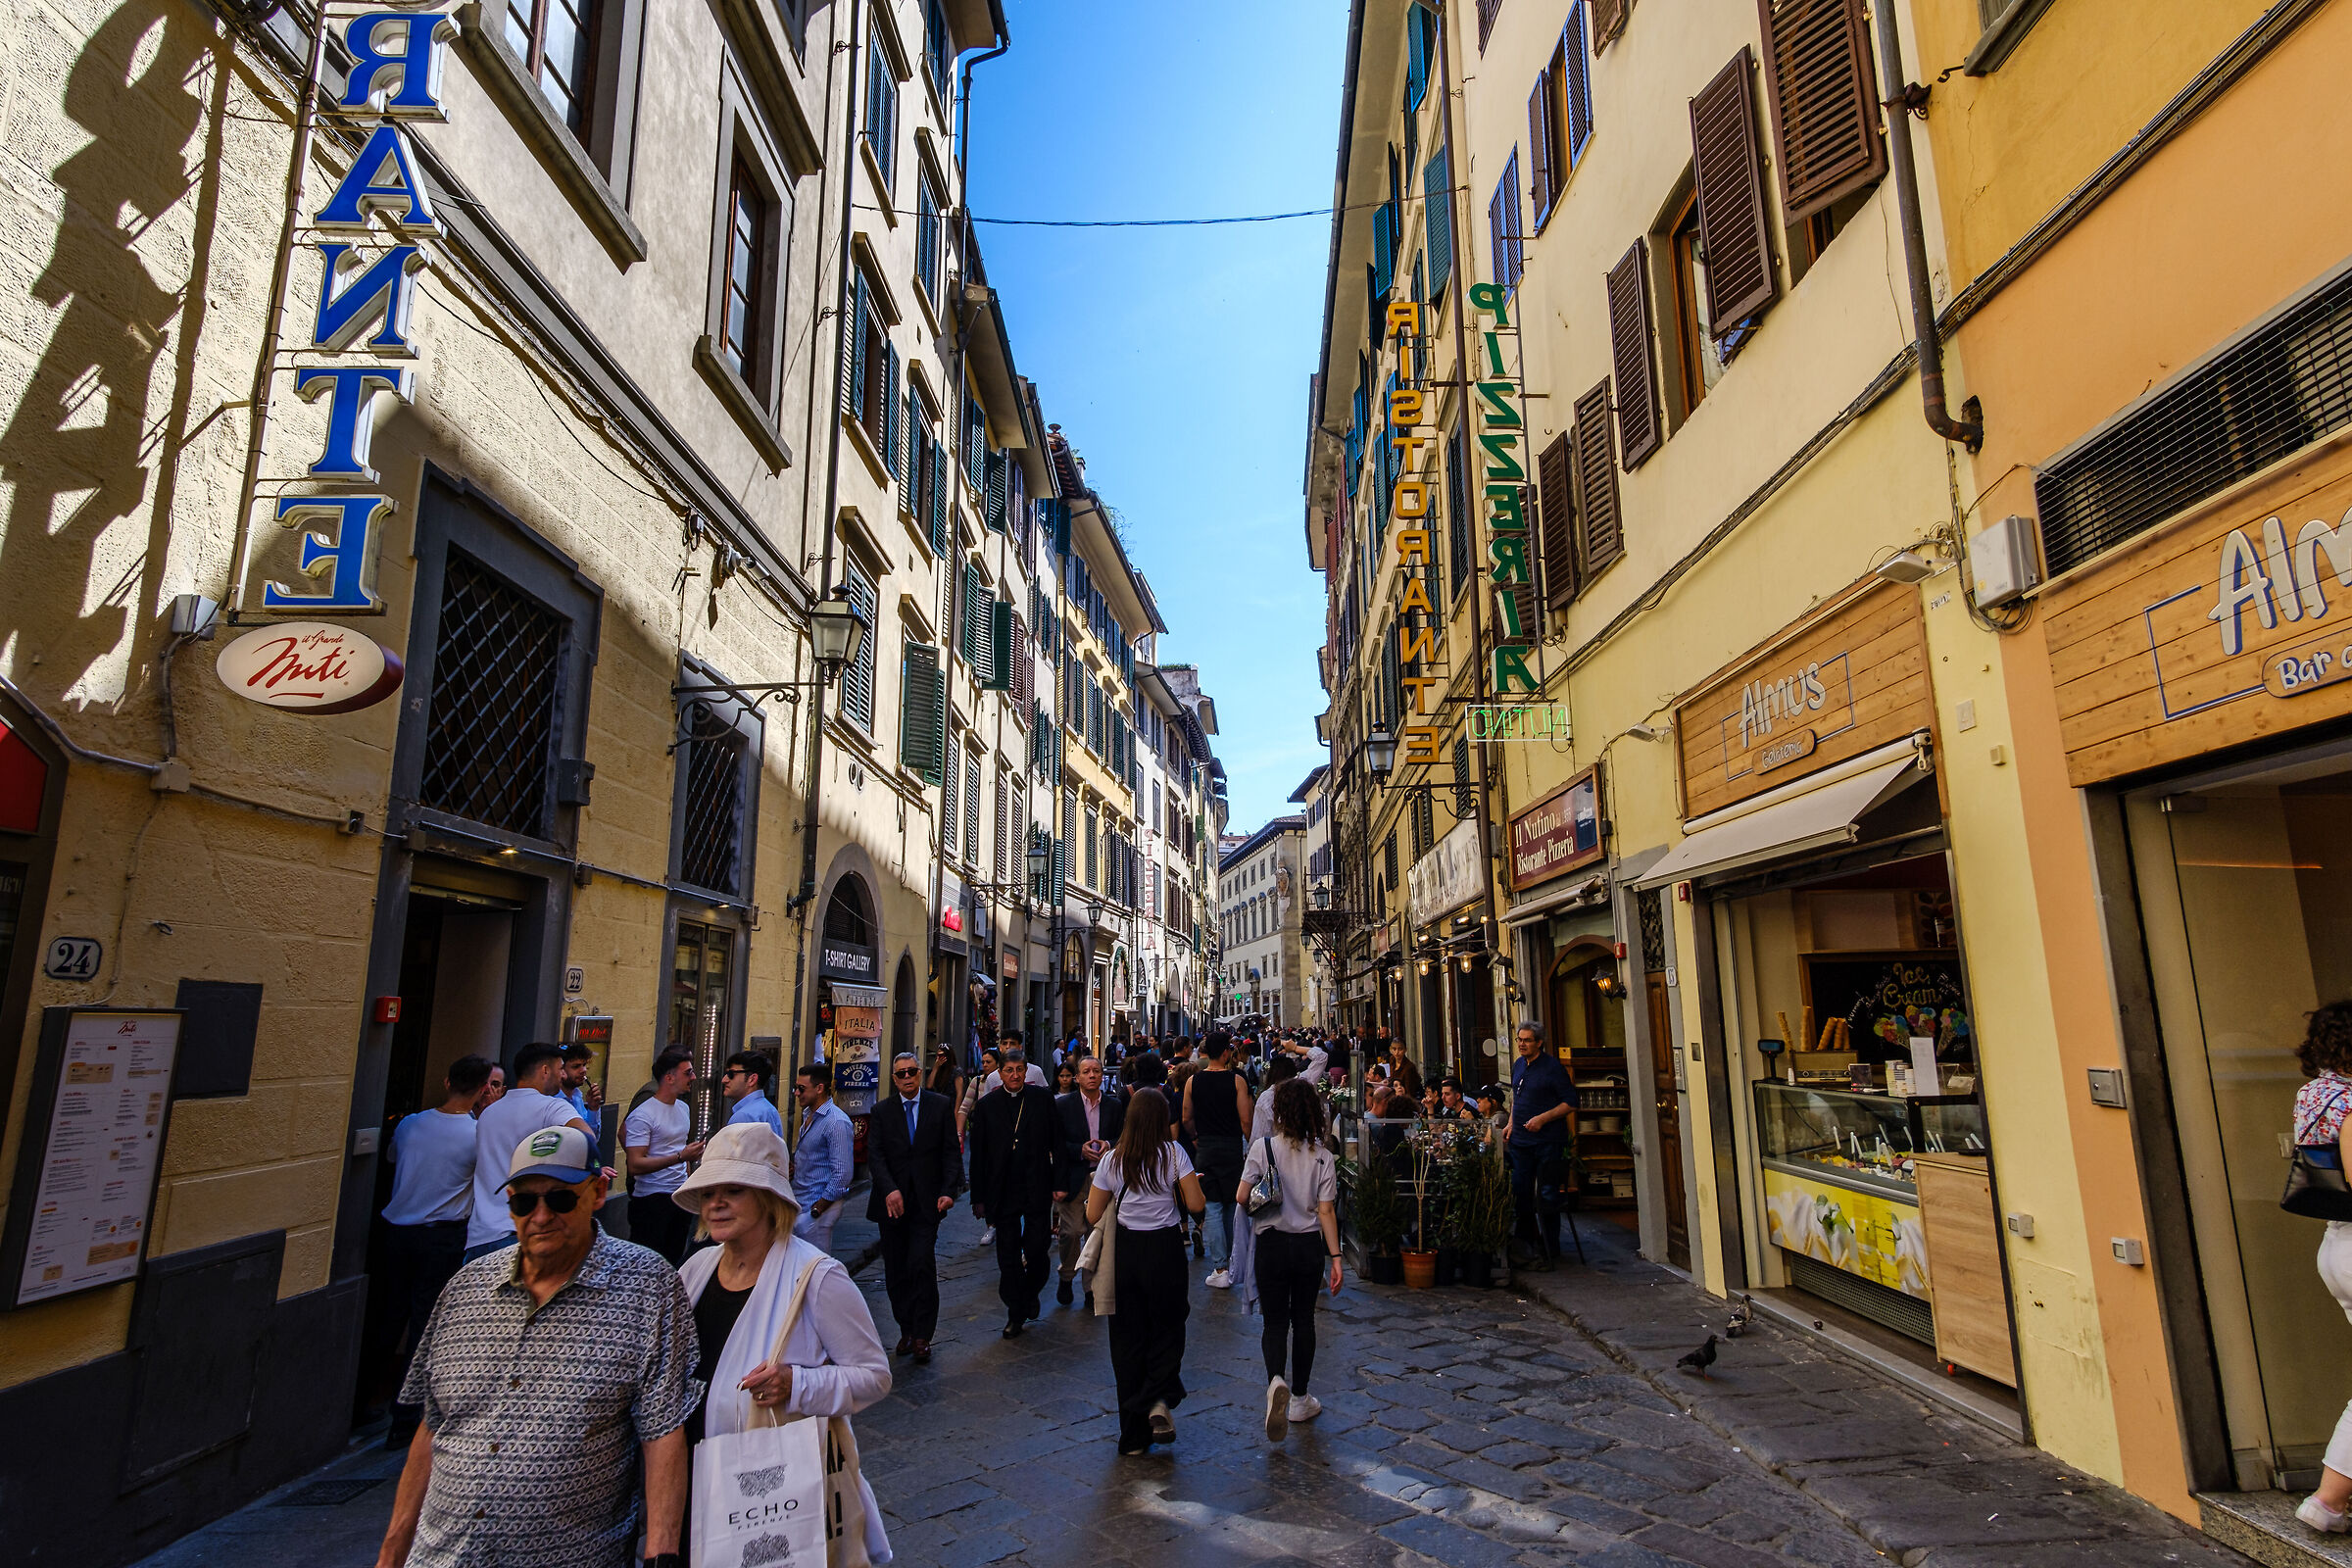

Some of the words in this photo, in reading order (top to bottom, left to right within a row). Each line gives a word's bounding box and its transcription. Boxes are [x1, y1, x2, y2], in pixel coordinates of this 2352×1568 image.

[309, 629, 344, 650] Grande
[2275, 651, 2333, 690] Bar
[1739, 662, 1826, 748] Almus
[1762, 740, 1802, 768] Gelateria
[1514, 824, 1523, 848] Il
[1524, 811, 1556, 843] Nutino
[1516, 847, 1546, 876] Ristorante
[1547, 830, 1574, 862] Pizzeria
[53, 942, 92, 974] 24
[825, 949, 847, 968] T-SHIRT
[847, 954, 871, 971] GALLERY
[568, 971, 581, 990] 22
[1883, 983, 1941, 1008] Cream
[845, 1018, 875, 1032] ITALIA
[842, 1037, 874, 1053] FIRENZE
[728, 1498, 799, 1525] ECHO
[737, 1514, 791, 1531] FIRENZE
